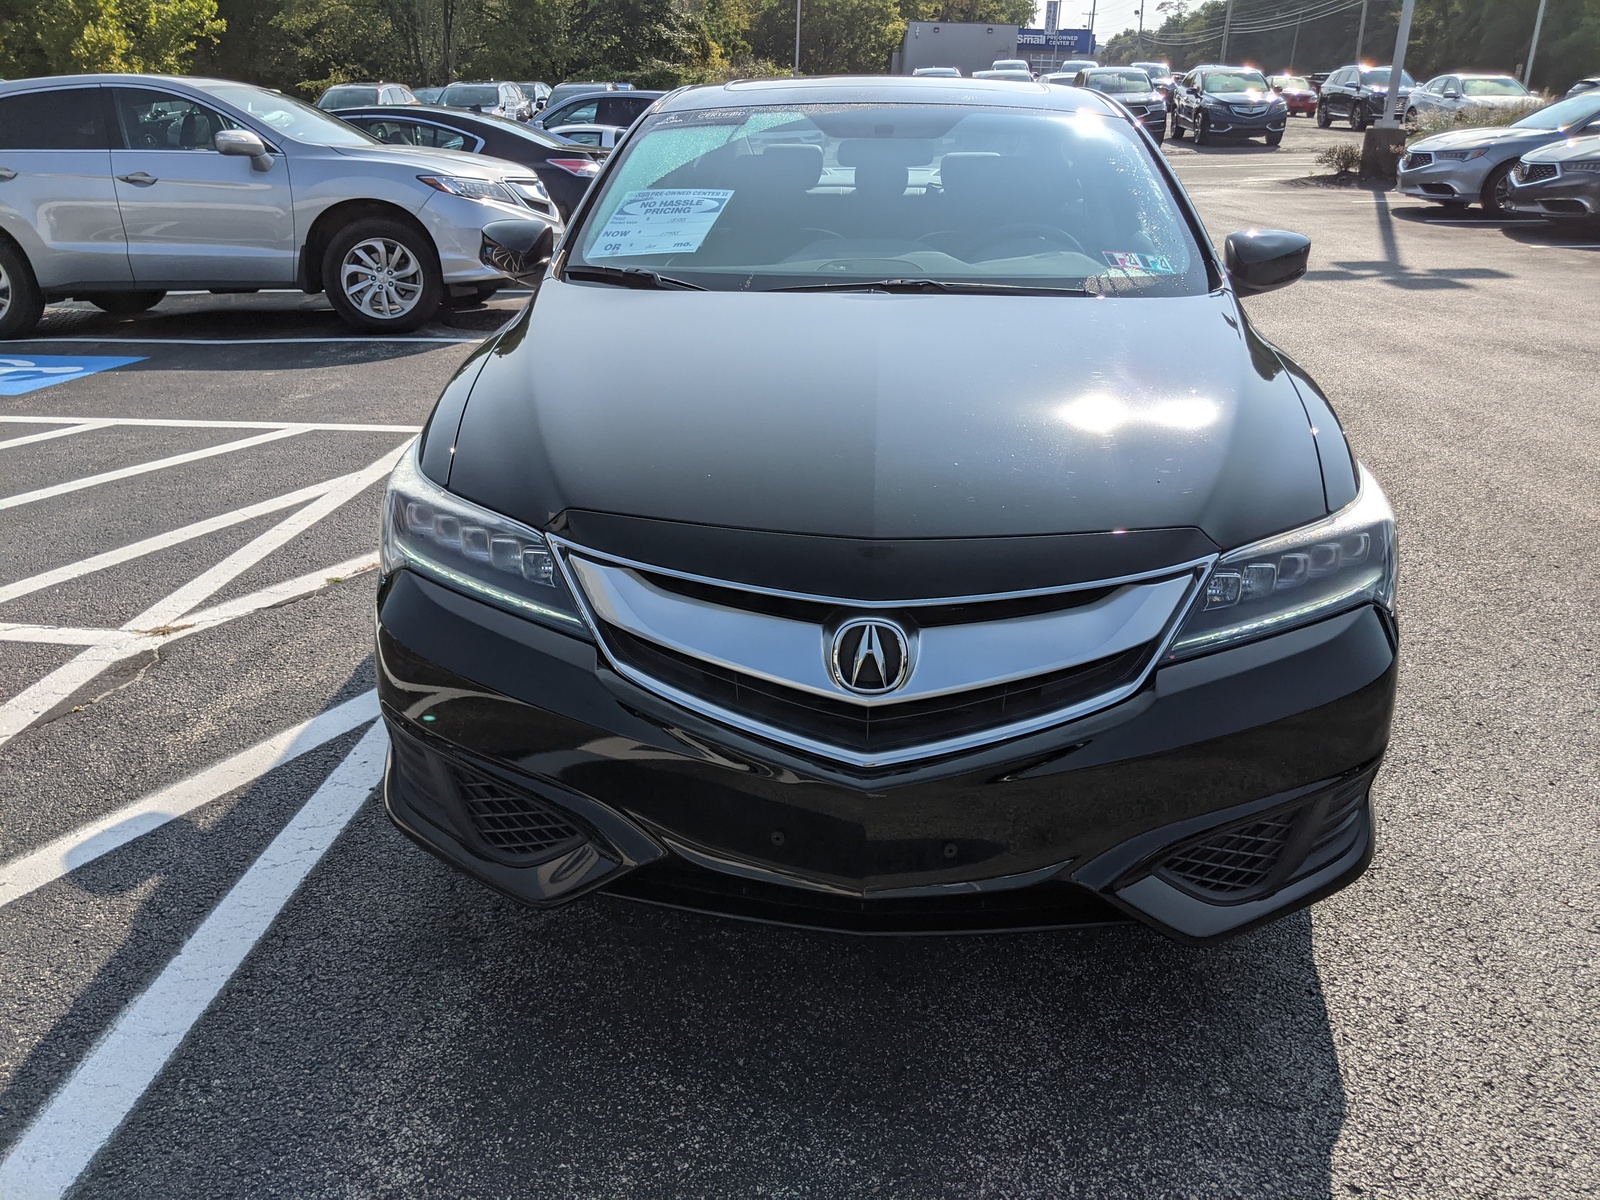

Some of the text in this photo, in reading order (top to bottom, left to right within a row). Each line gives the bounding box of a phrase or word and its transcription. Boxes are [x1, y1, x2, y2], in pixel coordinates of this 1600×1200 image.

[1017, 34, 1046, 45] Small
[640, 201, 657, 209] NO
[658, 199, 705, 208] HASSLE
[643, 207, 691, 216] PRICING
[602, 230, 632, 238] NOW
[603, 243, 622, 252] OR
